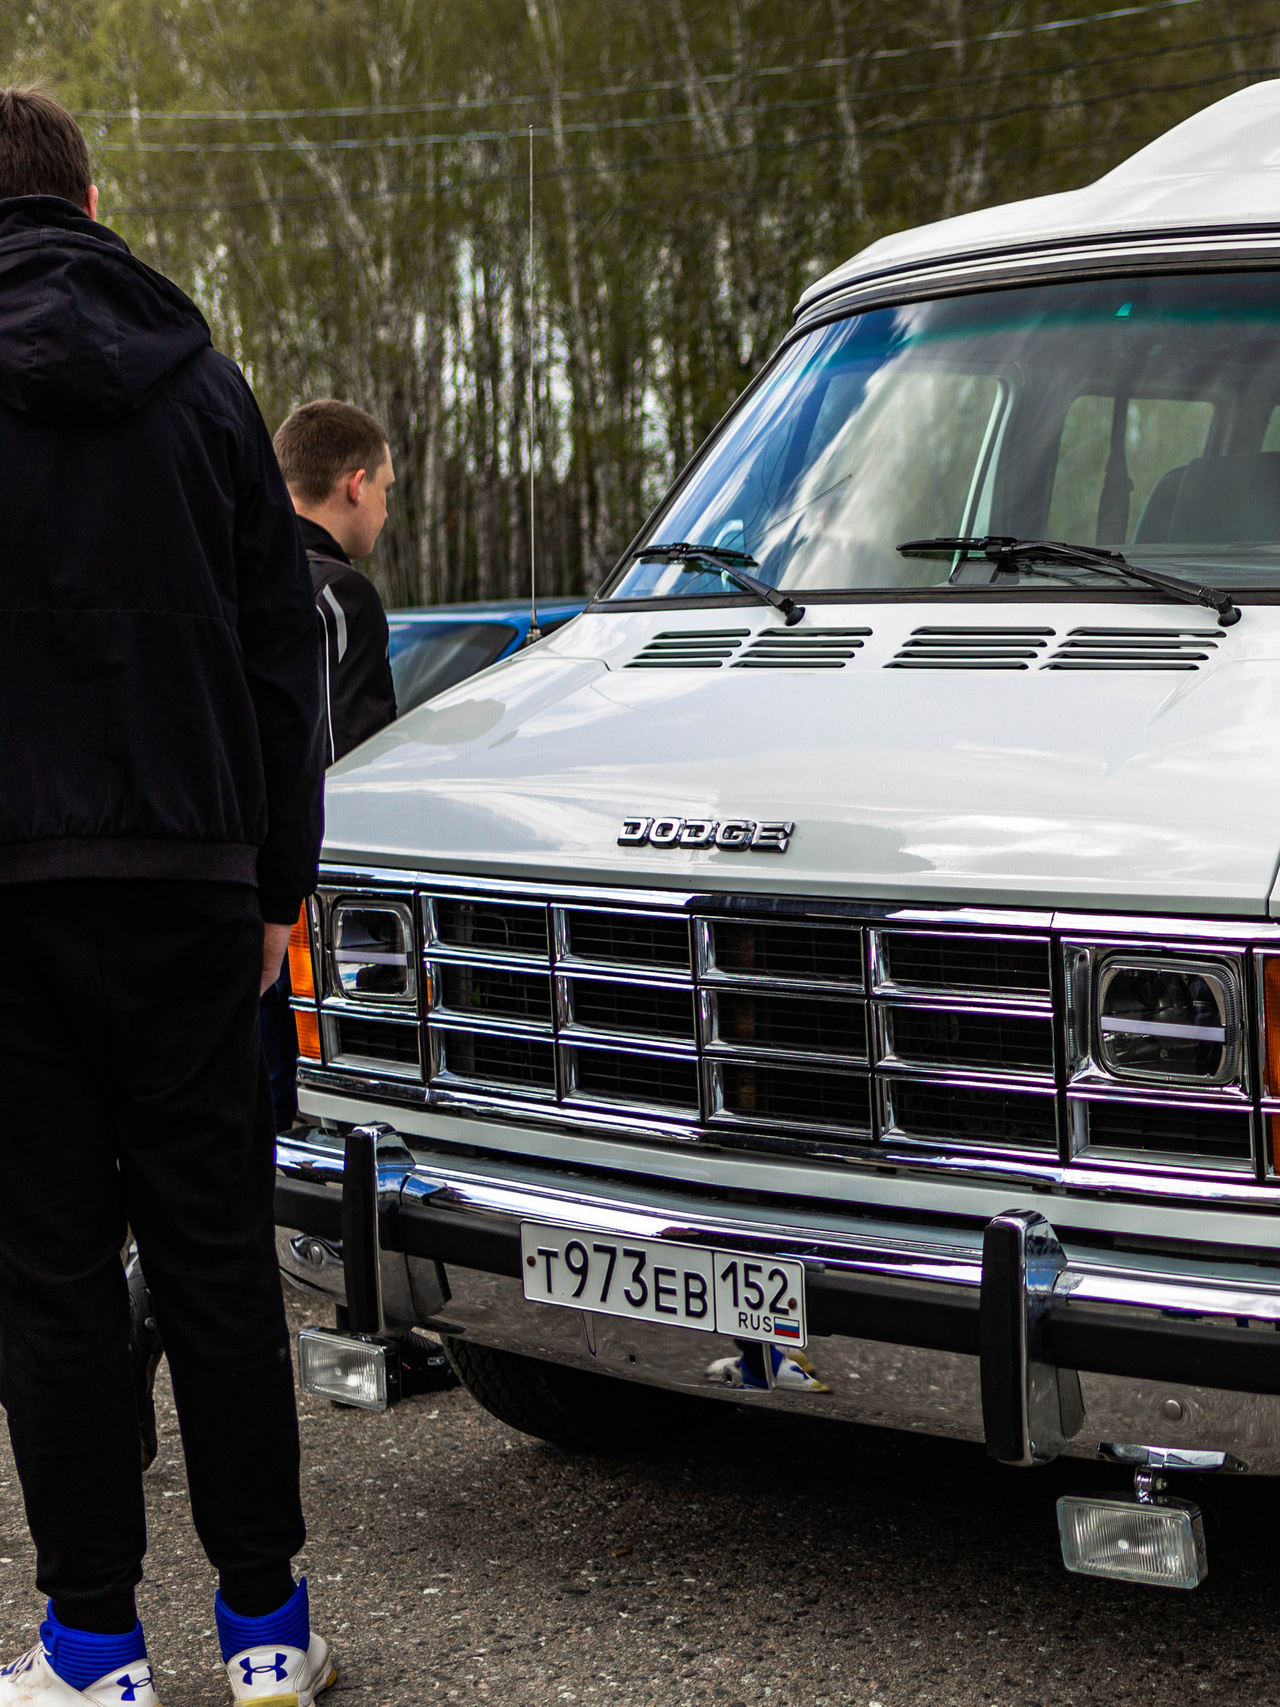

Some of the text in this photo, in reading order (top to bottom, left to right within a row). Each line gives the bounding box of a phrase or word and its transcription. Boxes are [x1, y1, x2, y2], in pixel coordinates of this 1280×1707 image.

[617, 816, 795, 853] DODGE
[720, 1260, 790, 1315] 152
[738, 1311, 773, 1333] RUS
